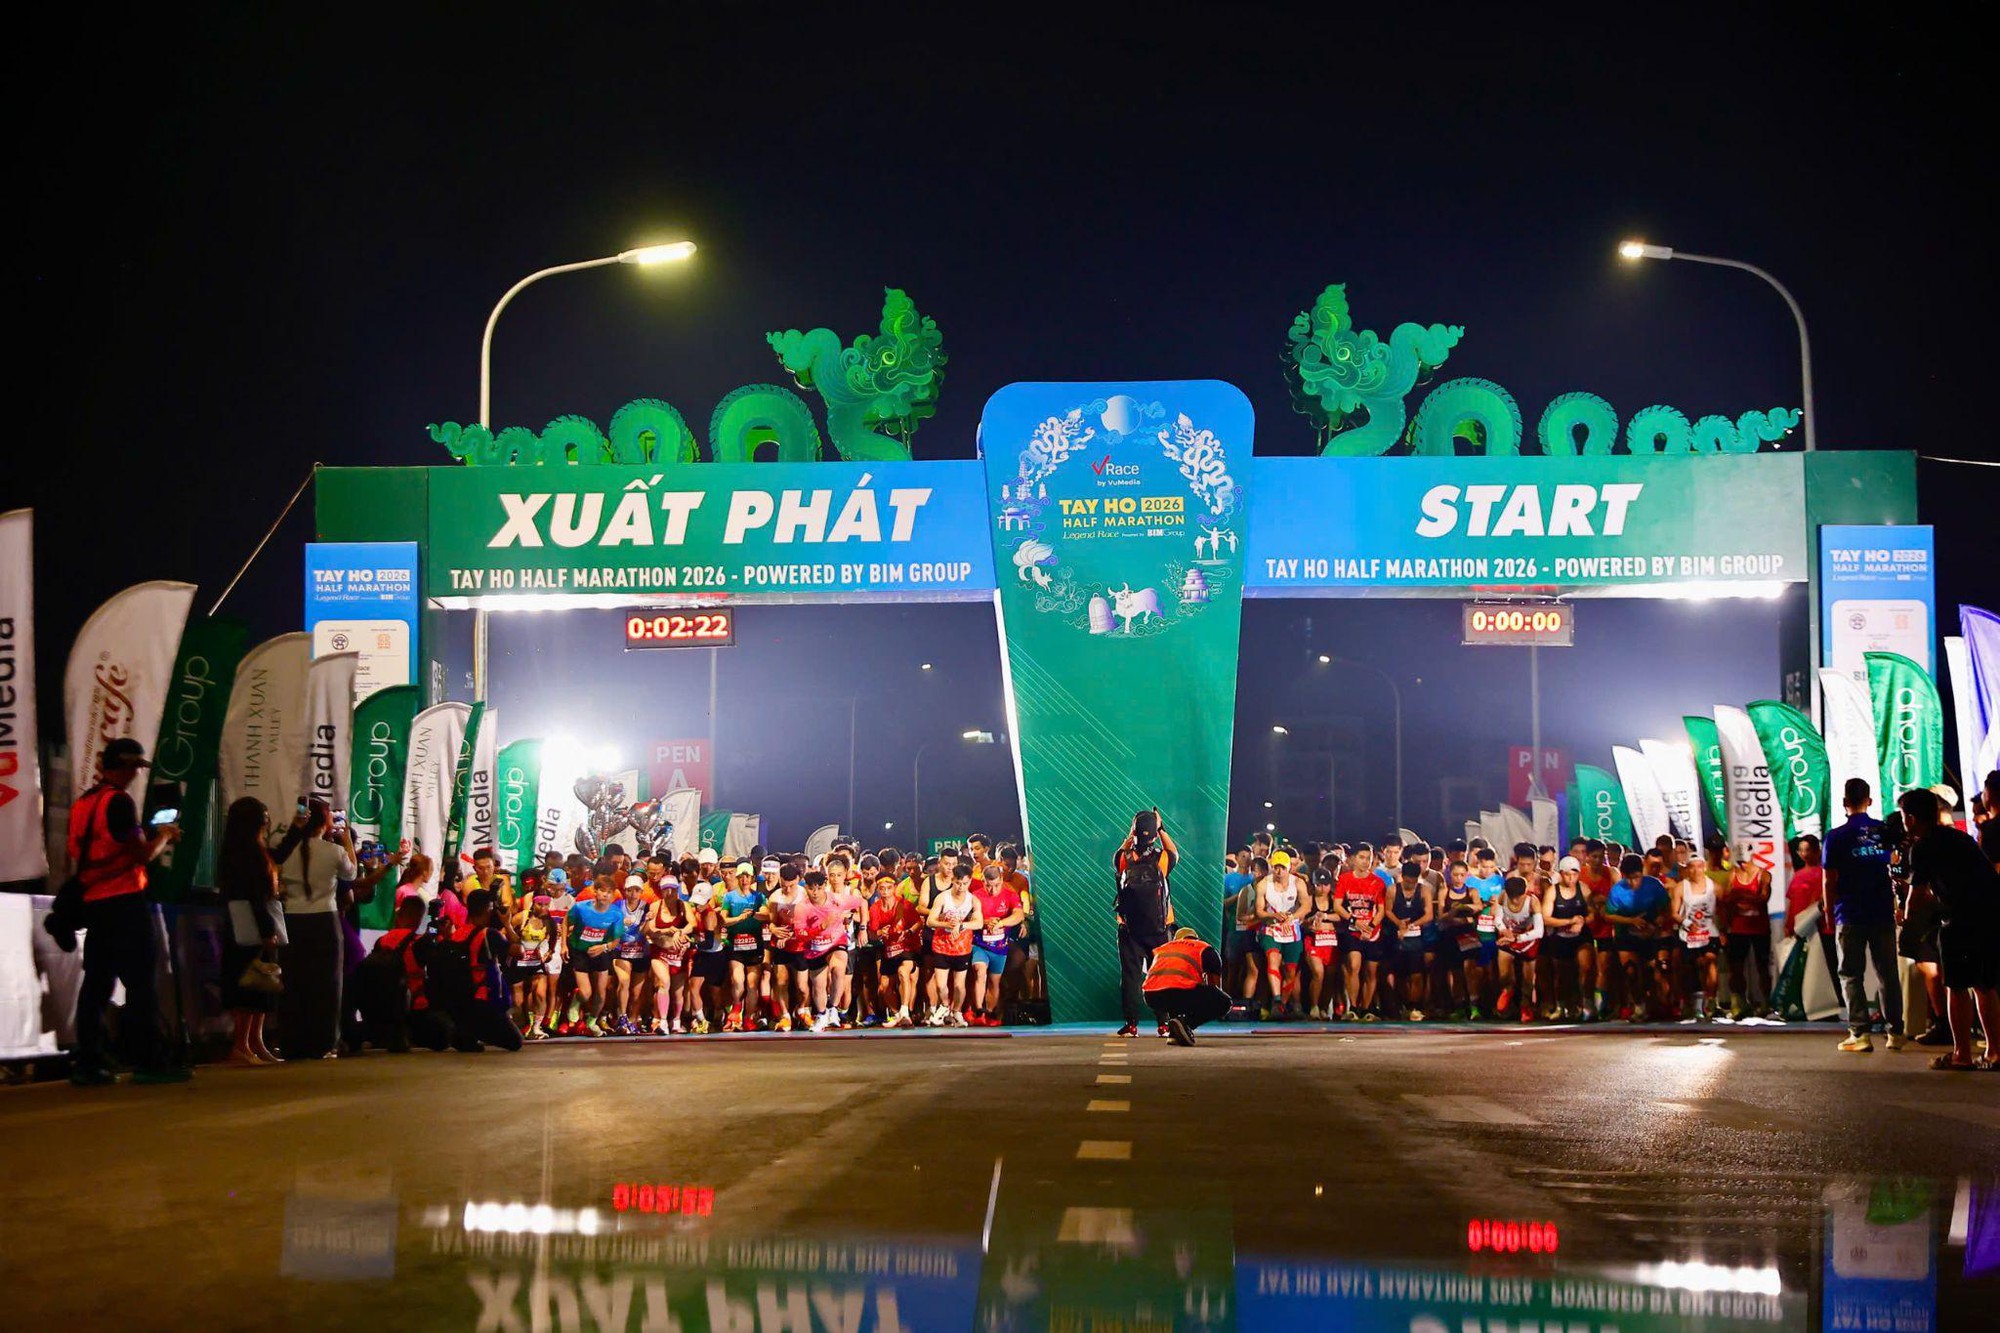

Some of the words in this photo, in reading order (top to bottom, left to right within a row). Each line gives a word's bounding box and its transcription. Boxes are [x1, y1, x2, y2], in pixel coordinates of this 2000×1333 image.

[487, 473, 706, 548] XUẤT
[723, 472, 933, 545] PHÁT
[1059, 499, 1099, 515] TAY
[1104, 497, 1137, 514] HO
[1144, 499, 1181, 511] 2026
[1414, 483, 1643, 537] START
[1063, 517, 1098, 528] HALF
[1104, 515, 1185, 527] MARATHON
[1062, 530, 1095, 540] Legend
[1097, 530, 1119, 538] Race
[1266, 559, 1298, 579] TAY
[1304, 558, 1328, 579] HO
[1333, 558, 1381, 579] HALF
[1386, 558, 1488, 578] MARATHON
[1493, 557, 1537, 578] 2026
[1555, 557, 1647, 577] POWERED
[1652, 556, 1675, 576] BY
[1680, 556, 1715, 576] BIM
[1720, 555, 1784, 575] GROUP
[1830, 549, 1861, 562] TAY
[1864, 549, 1890, 562] HO
[1832, 563, 1860, 572] HALF
[1864, 563, 1927, 572] MARATHON
[313, 569, 345, 582] TAY
[348, 569, 374, 582] HO
[379, 570, 408, 580] 2026
[316, 584, 343, 592] HALF
[348, 583, 411, 592] MARATHON
[450, 569, 483, 590] TAY
[490, 568, 515, 589] HO
[521, 567, 568, 589] HALF
[573, 566, 677, 588] MARATHON
[682, 566, 726, 586] 2026
[744, 565, 835, 586] POWERED
[841, 564, 864, 584] BY
[869, 563, 904, 584] BIM
[909, 562, 972, 583] GROUP
[627, 615, 729, 639] 0:02:22
[1471, 610, 1562, 632] 0:00:00
[249, 668, 268, 719] XUAN
[268, 708, 282, 754] VALLEY
[244, 725, 263, 790] THANH
[414, 727, 433, 770] XUAN
[656, 745, 701, 763] PEN
[1518, 751, 1559, 769] PN
[425, 760, 440, 799] VALLEY
[668, 768, 690, 794] A
[406, 772, 424, 826] THANH
[1595, 790, 1618, 841] roup
